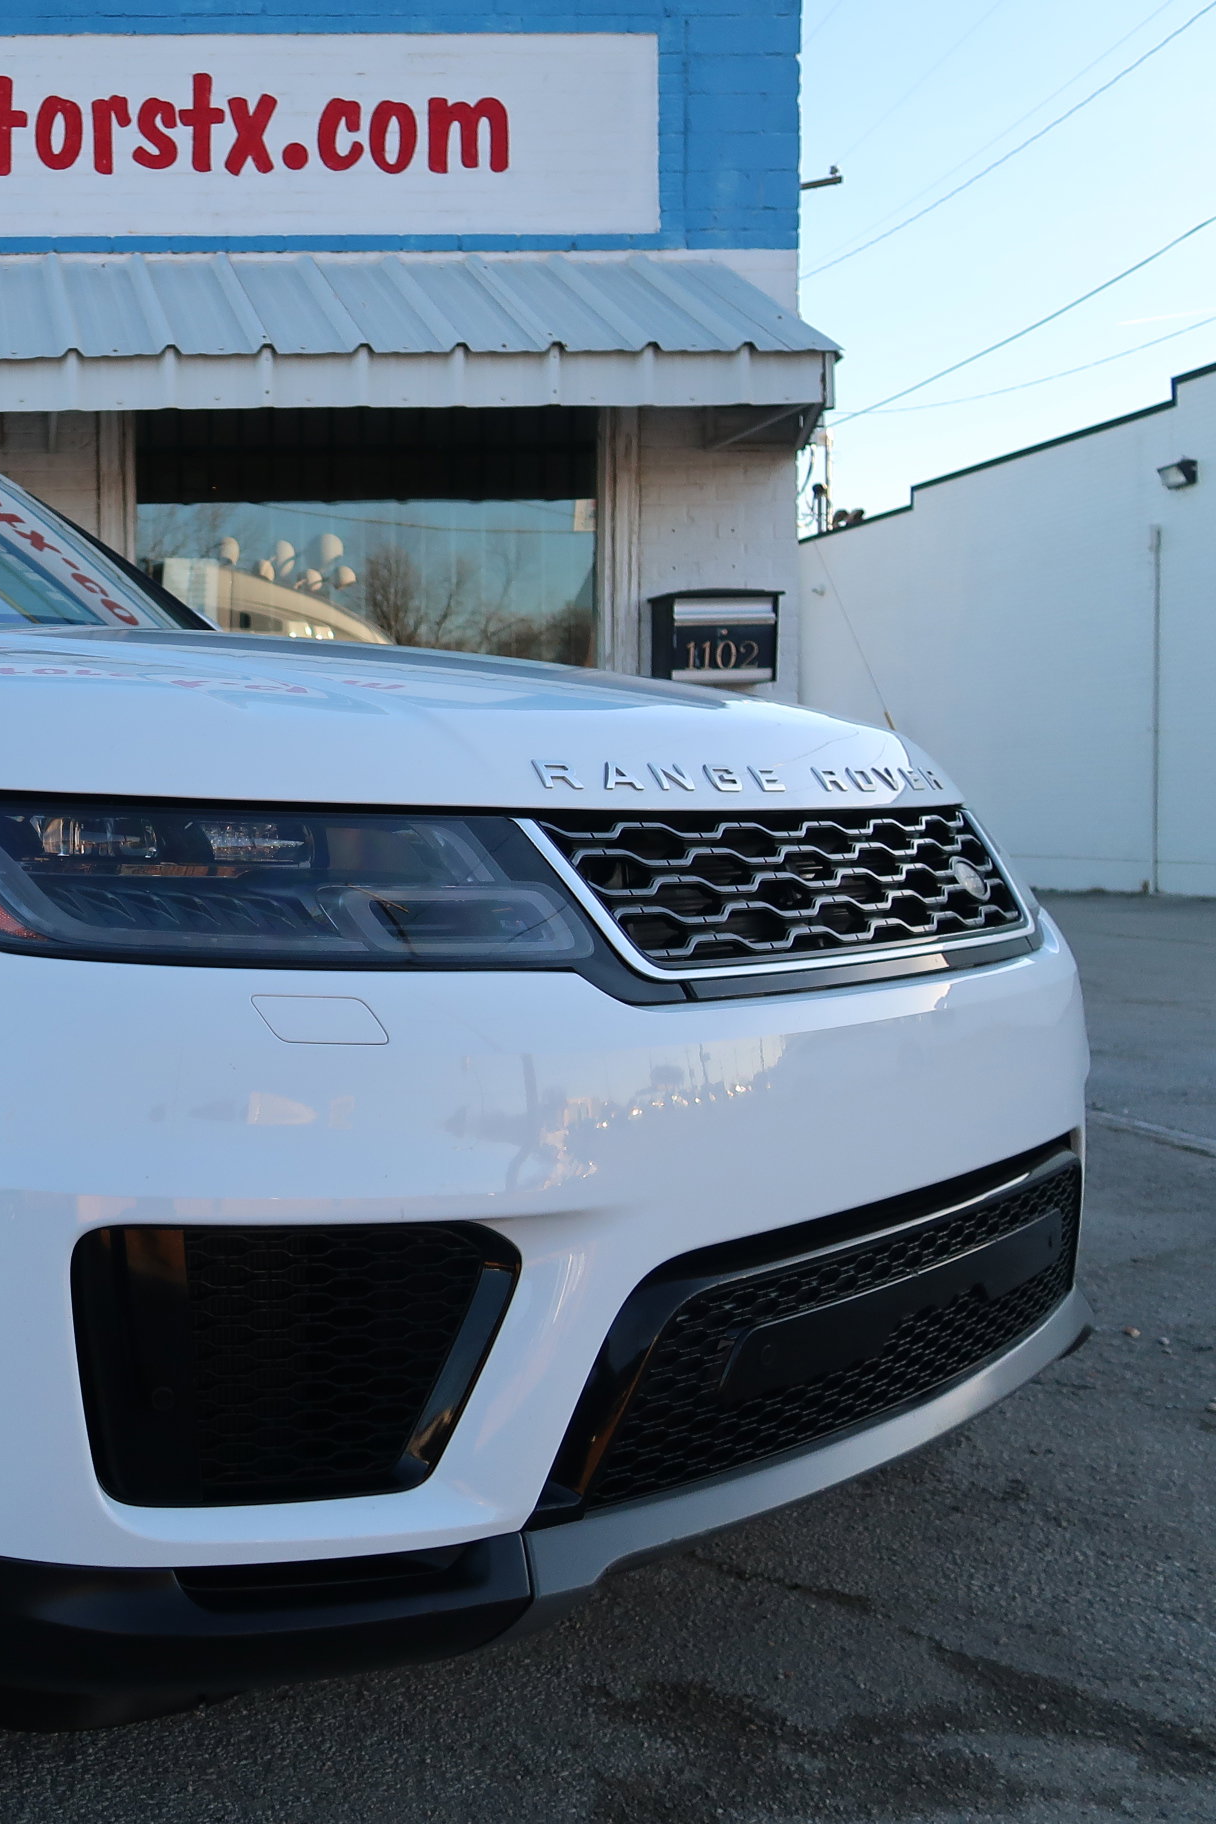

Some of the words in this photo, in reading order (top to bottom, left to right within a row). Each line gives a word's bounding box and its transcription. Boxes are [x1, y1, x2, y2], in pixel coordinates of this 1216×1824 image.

[685, 640, 760, 670] 1102
[531, 759, 786, 793] RANGE
[810, 766, 944, 793] ROVER
